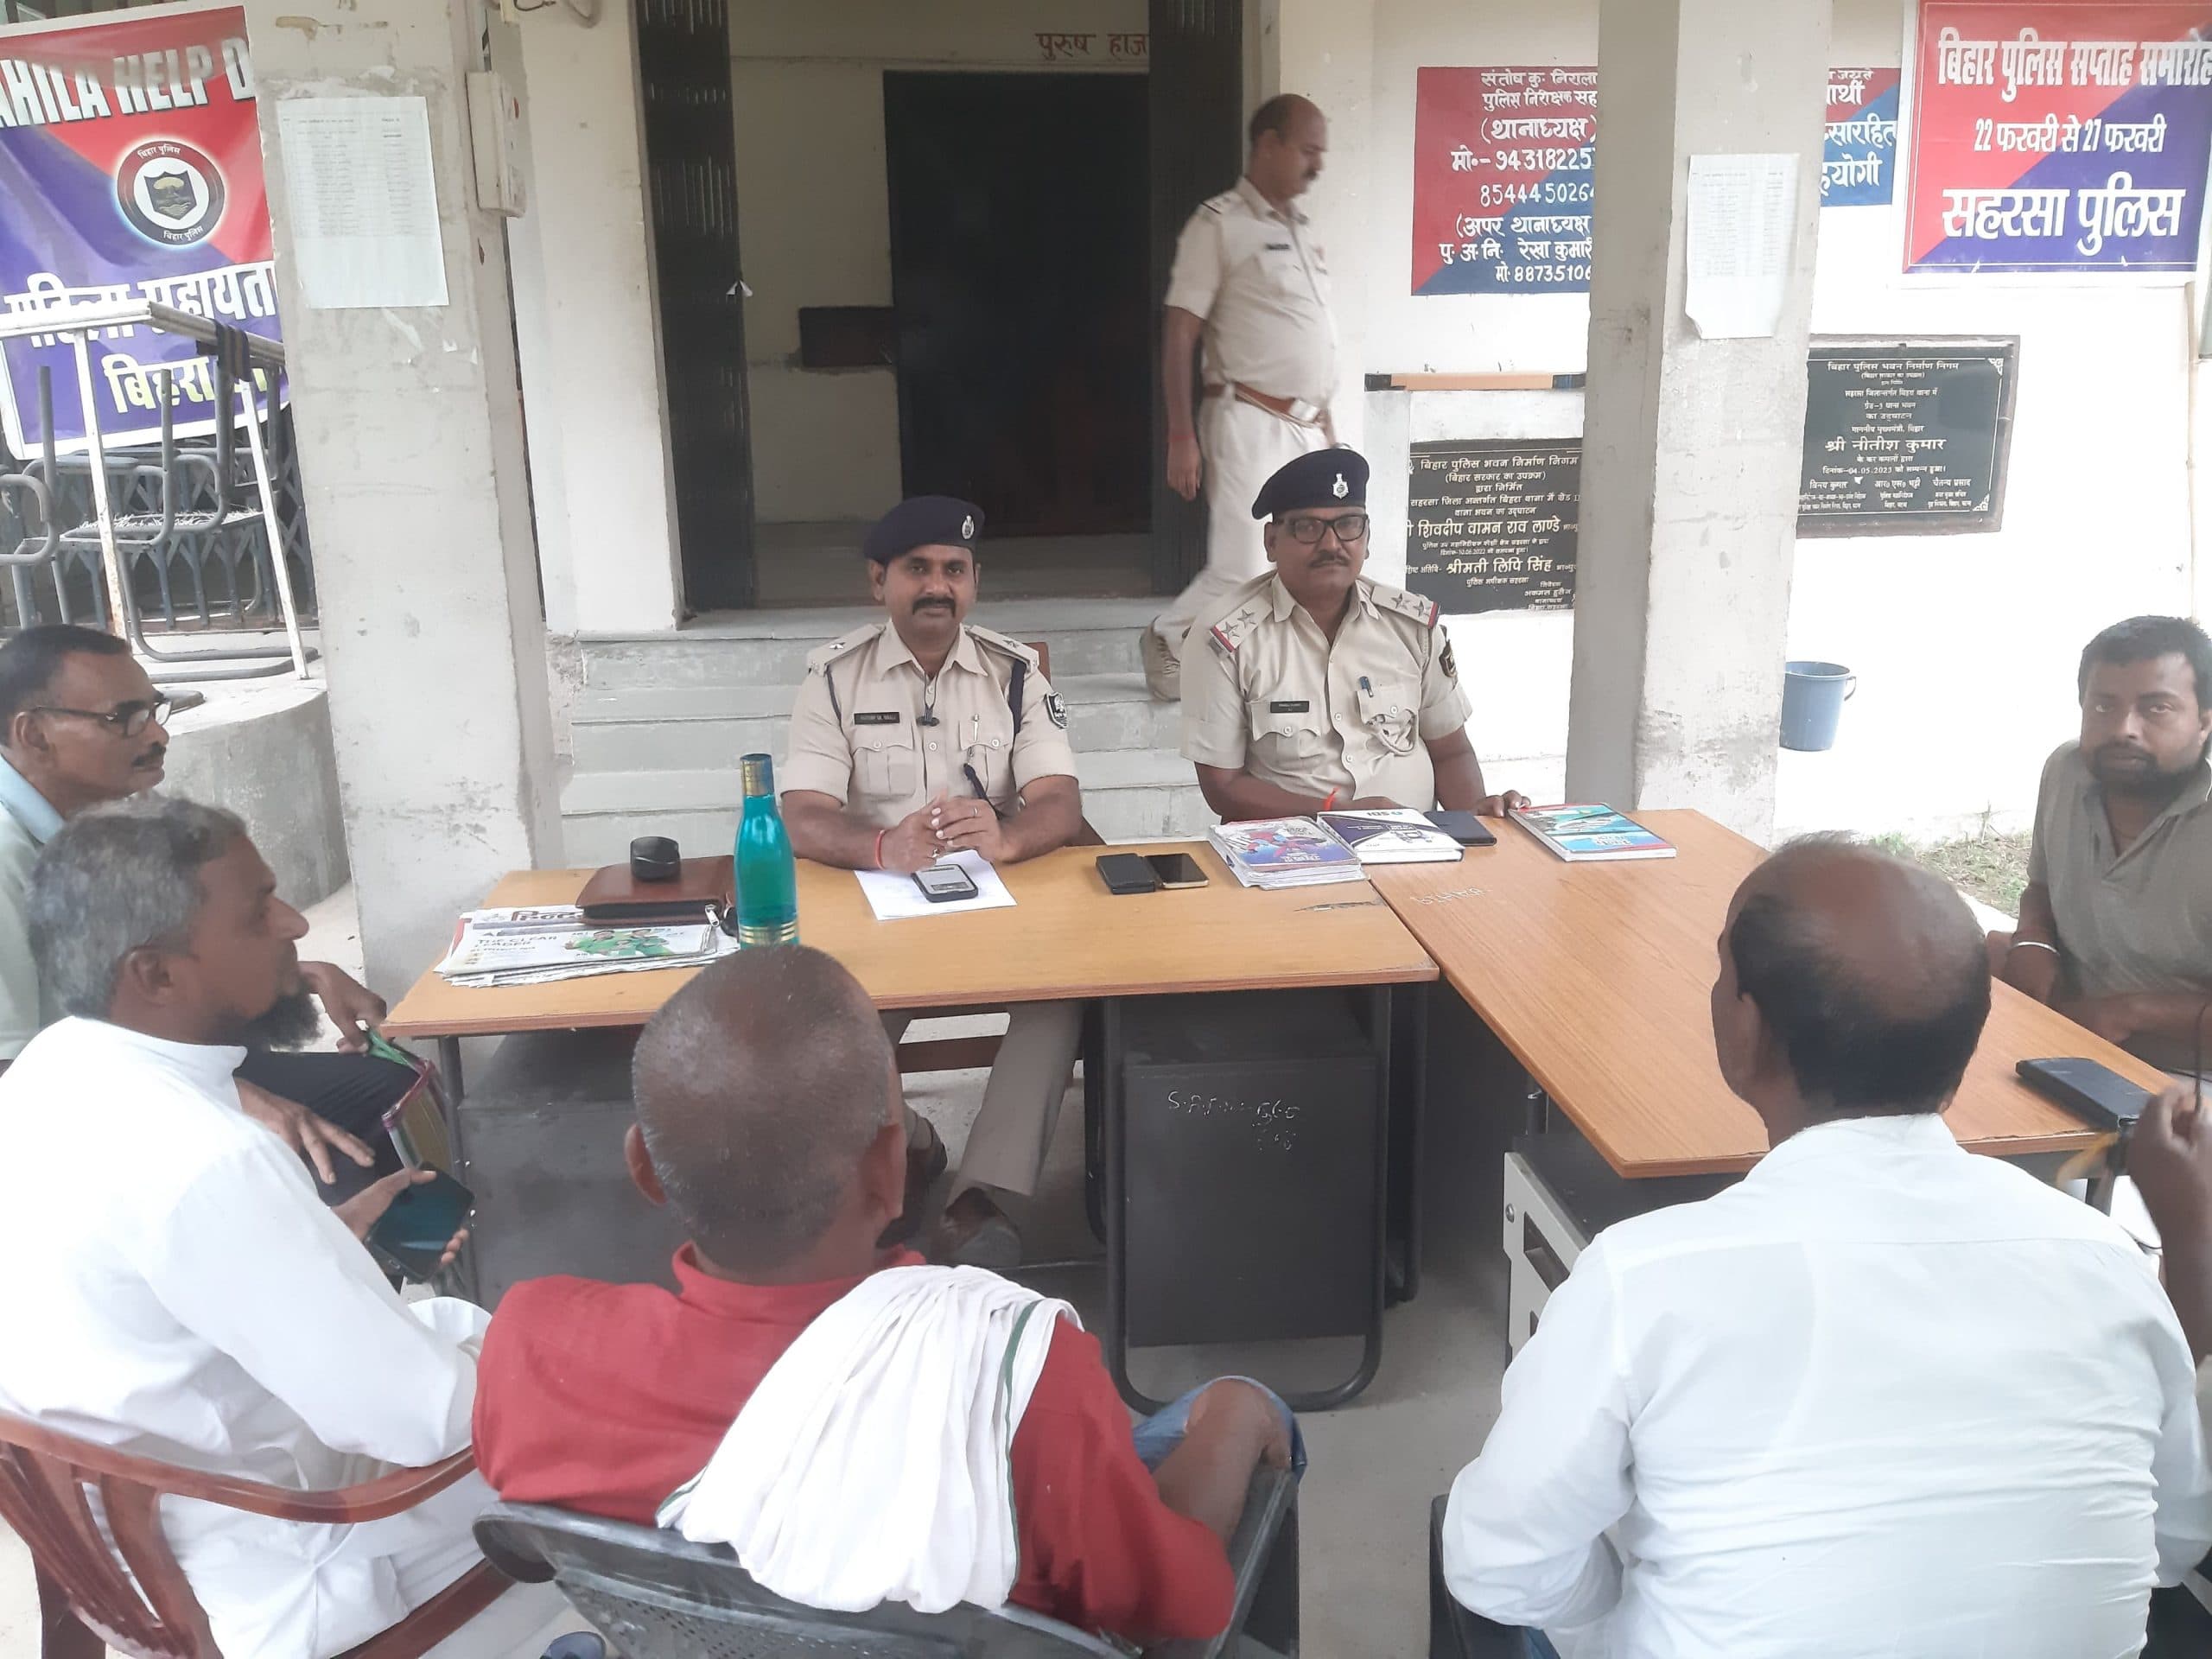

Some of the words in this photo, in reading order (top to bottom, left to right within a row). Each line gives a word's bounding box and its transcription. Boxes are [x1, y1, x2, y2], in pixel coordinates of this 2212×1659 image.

[1035, 33, 1096, 60] पुरुष
[1107, 33, 1149, 61] हाज
[1550, 69, 1598, 86] निराला
[1938, 27, 1999, 86] बिहार
[2001, 28, 2067, 102] पुलिस
[2070, 41, 2137, 86] सप्ताह
[113, 45, 213, 114] HELP
[1482, 88, 1521, 112] पुलिस
[1824, 112, 1897, 149] सारहित
[1974, 118, 1993, 152] 22
[1996, 113, 2059, 152] फरवरी
[2061, 112, 2082, 153] से
[2082, 118, 2101, 151] 27
[2104, 112, 2166, 154] फरवरी
[1819, 150, 1884, 196] हयोगी
[1942, 188, 2070, 240] सहरसा
[2076, 171, 2186, 257] पुलिस
[1517, 238, 1551, 260] रेखा
[137, 261, 276, 334] सहायत
[1828, 361, 1850, 371] बिहार
[1853, 361, 1878, 372] पुलिस
[1906, 360, 1933, 371] निर्माण
[1937, 361, 1959, 370] निगम
[1825, 436, 1847, 451] श्री
[1852, 435, 1900, 451] नीतीश
[1905, 438, 1947, 453] कुमार
[1421, 459, 1447, 470] बिहार
[1451, 457, 1480, 472] पुलिस
[1484, 460, 1508, 468] भवन
[1512, 455, 1545, 467] निर्माण
[1549, 455, 1579, 466] निगम
[1418, 518, 1464, 537] शिवदीप
[1467, 521, 1503, 535] वामन
[1506, 520, 1529, 535] राव
[1532, 515, 1561, 533] लाण्डे
[1446, 558, 1489, 574] श्रीमती
[1493, 556, 1524, 573] लिपि
[1527, 555, 1553, 572] सिंह
